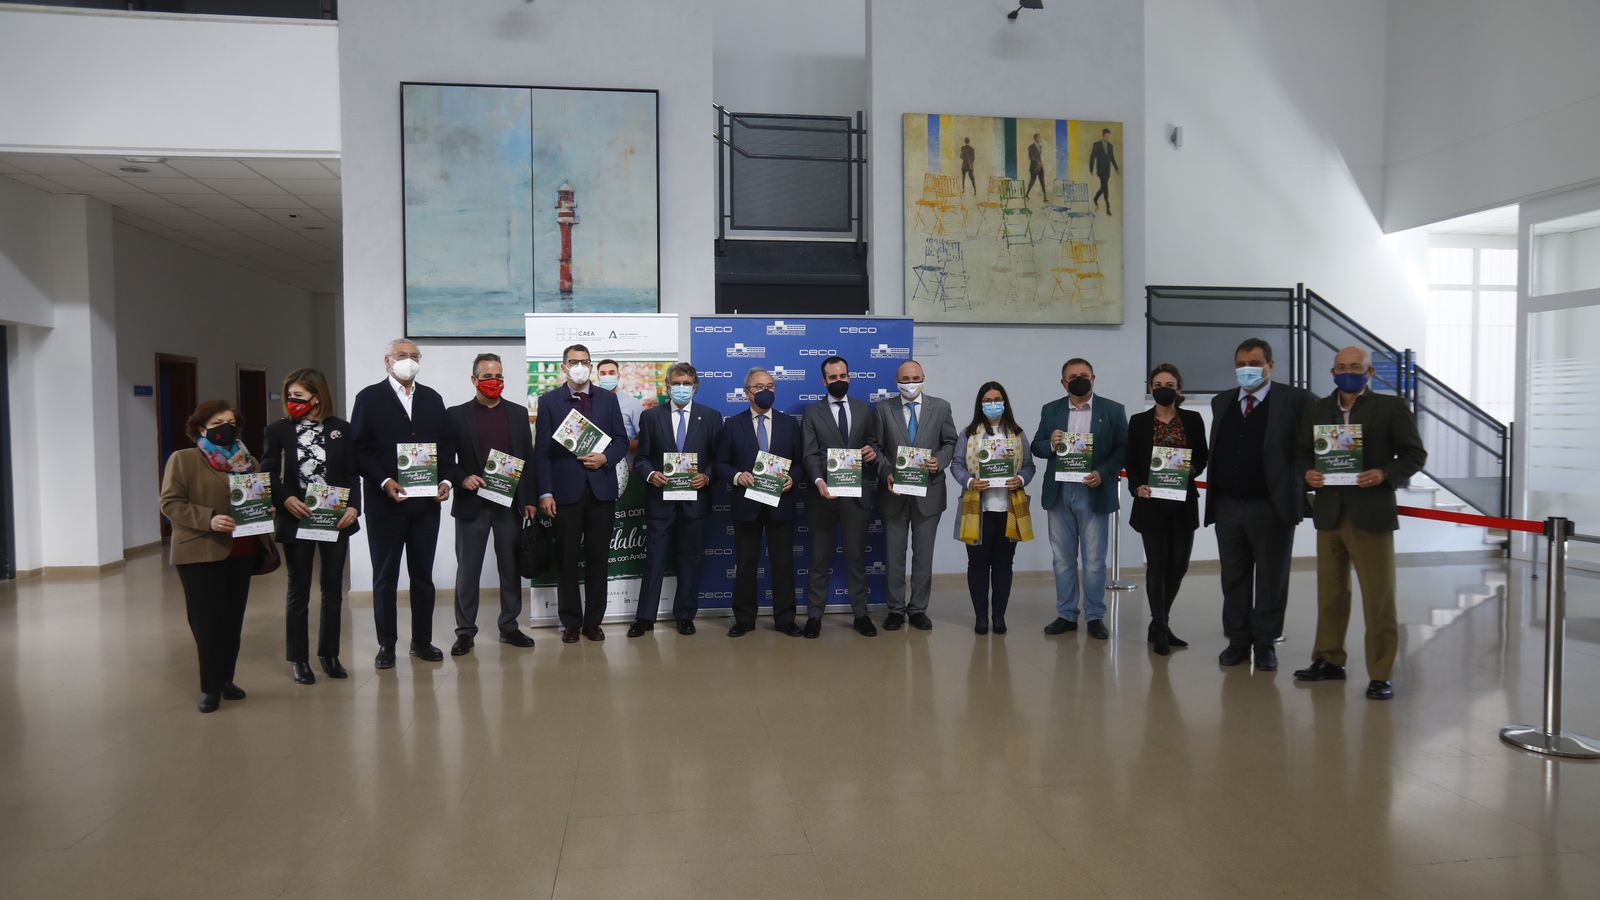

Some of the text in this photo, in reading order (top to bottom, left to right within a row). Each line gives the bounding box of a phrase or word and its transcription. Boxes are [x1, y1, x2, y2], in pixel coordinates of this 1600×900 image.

[628, 508, 646, 517] con
[610, 527, 647, 551] dalu
[630, 552, 647, 561] Anda
